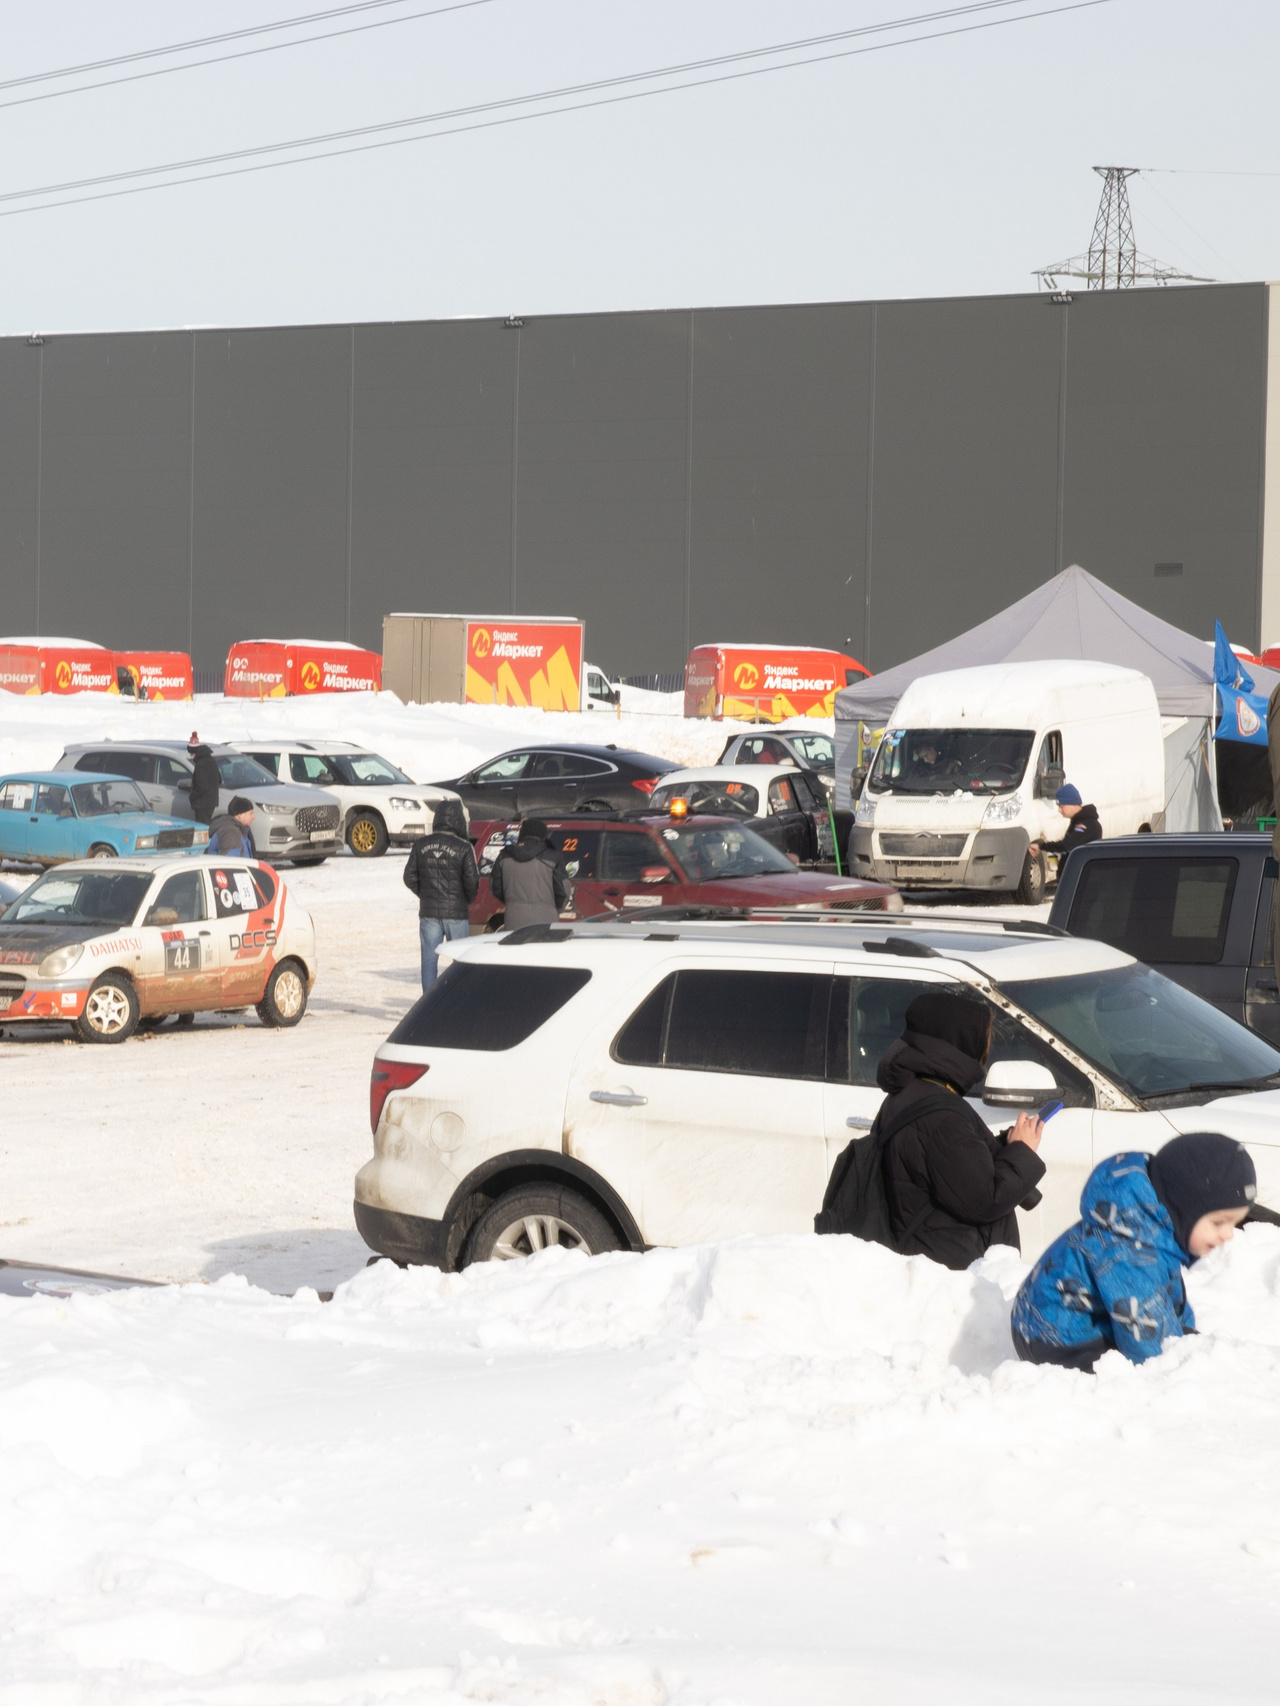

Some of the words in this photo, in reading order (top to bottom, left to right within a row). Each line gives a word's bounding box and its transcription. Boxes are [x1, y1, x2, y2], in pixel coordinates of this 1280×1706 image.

[493, 630, 518, 642] Яндекс
[492, 642, 543, 659] Маркет
[71, 661, 91, 672] Яндекс
[140, 665, 163, 676] Яндекс
[323, 661, 348, 674] Яндекс
[764, 664, 799, 676] Яндекс
[71, 672, 111, 687] Маркет
[139, 674, 185, 688] Маркет
[231, 671, 283, 684] Маркет
[323, 673, 373, 690] Маркет
[763, 676, 834, 692] Маркет
[562, 838, 579, 851] 22
[90, 937, 142, 957] DAIHATSU
[229, 930, 277, 950] DCCS
[174, 946, 190, 969] 44
